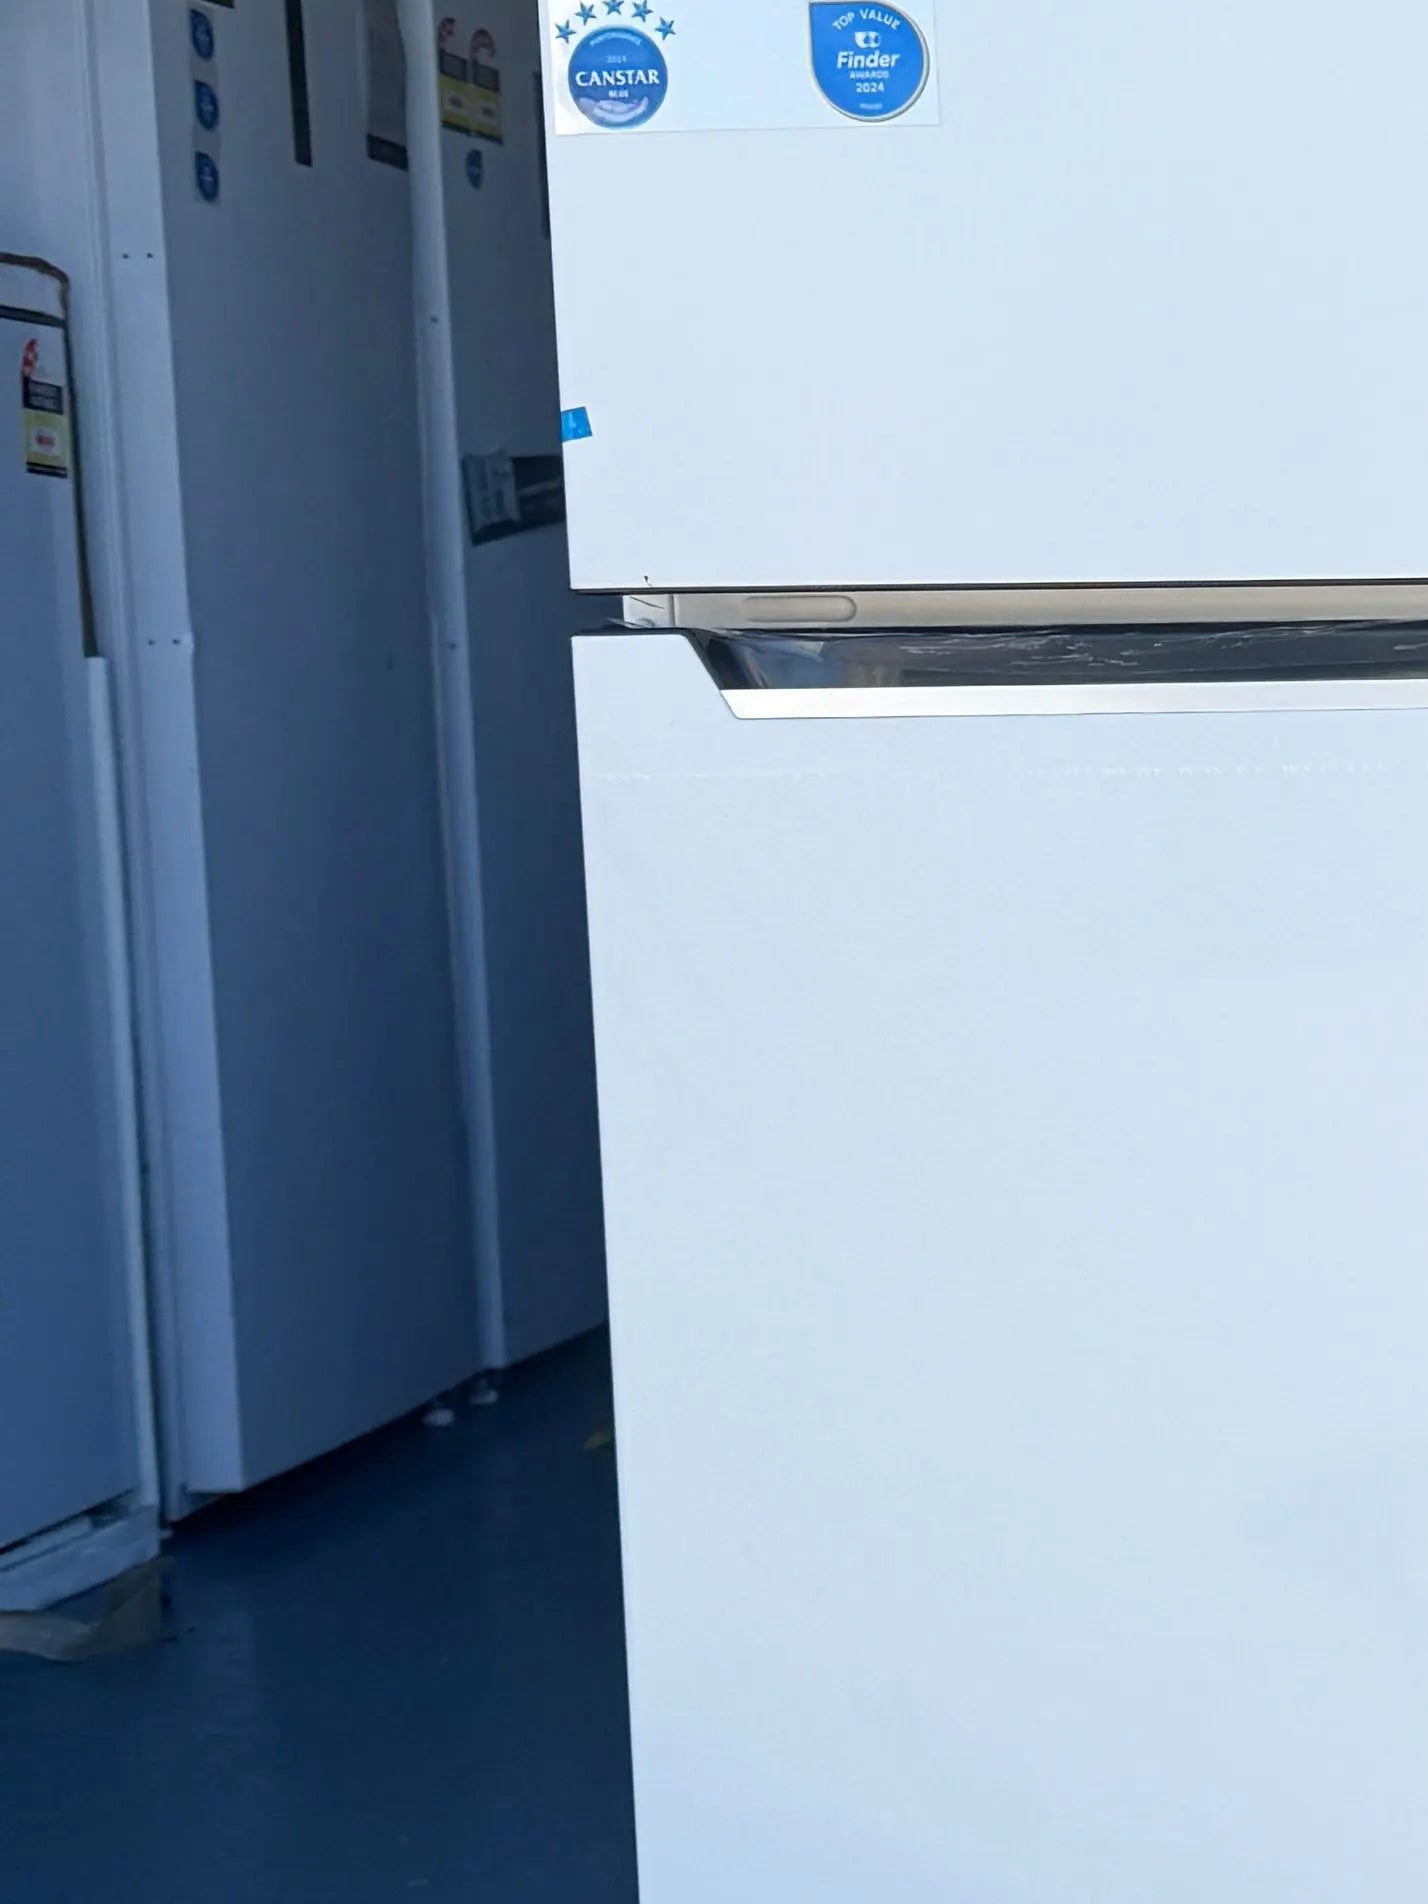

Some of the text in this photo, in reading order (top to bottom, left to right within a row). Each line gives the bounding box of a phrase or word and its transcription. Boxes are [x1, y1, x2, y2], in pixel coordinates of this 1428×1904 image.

[832, 8, 901, 31] TOP VALUE
[836, 50, 900, 69] Finder
[575, 69, 660, 86] CANSTAR
[856, 82, 884, 92] 2024
